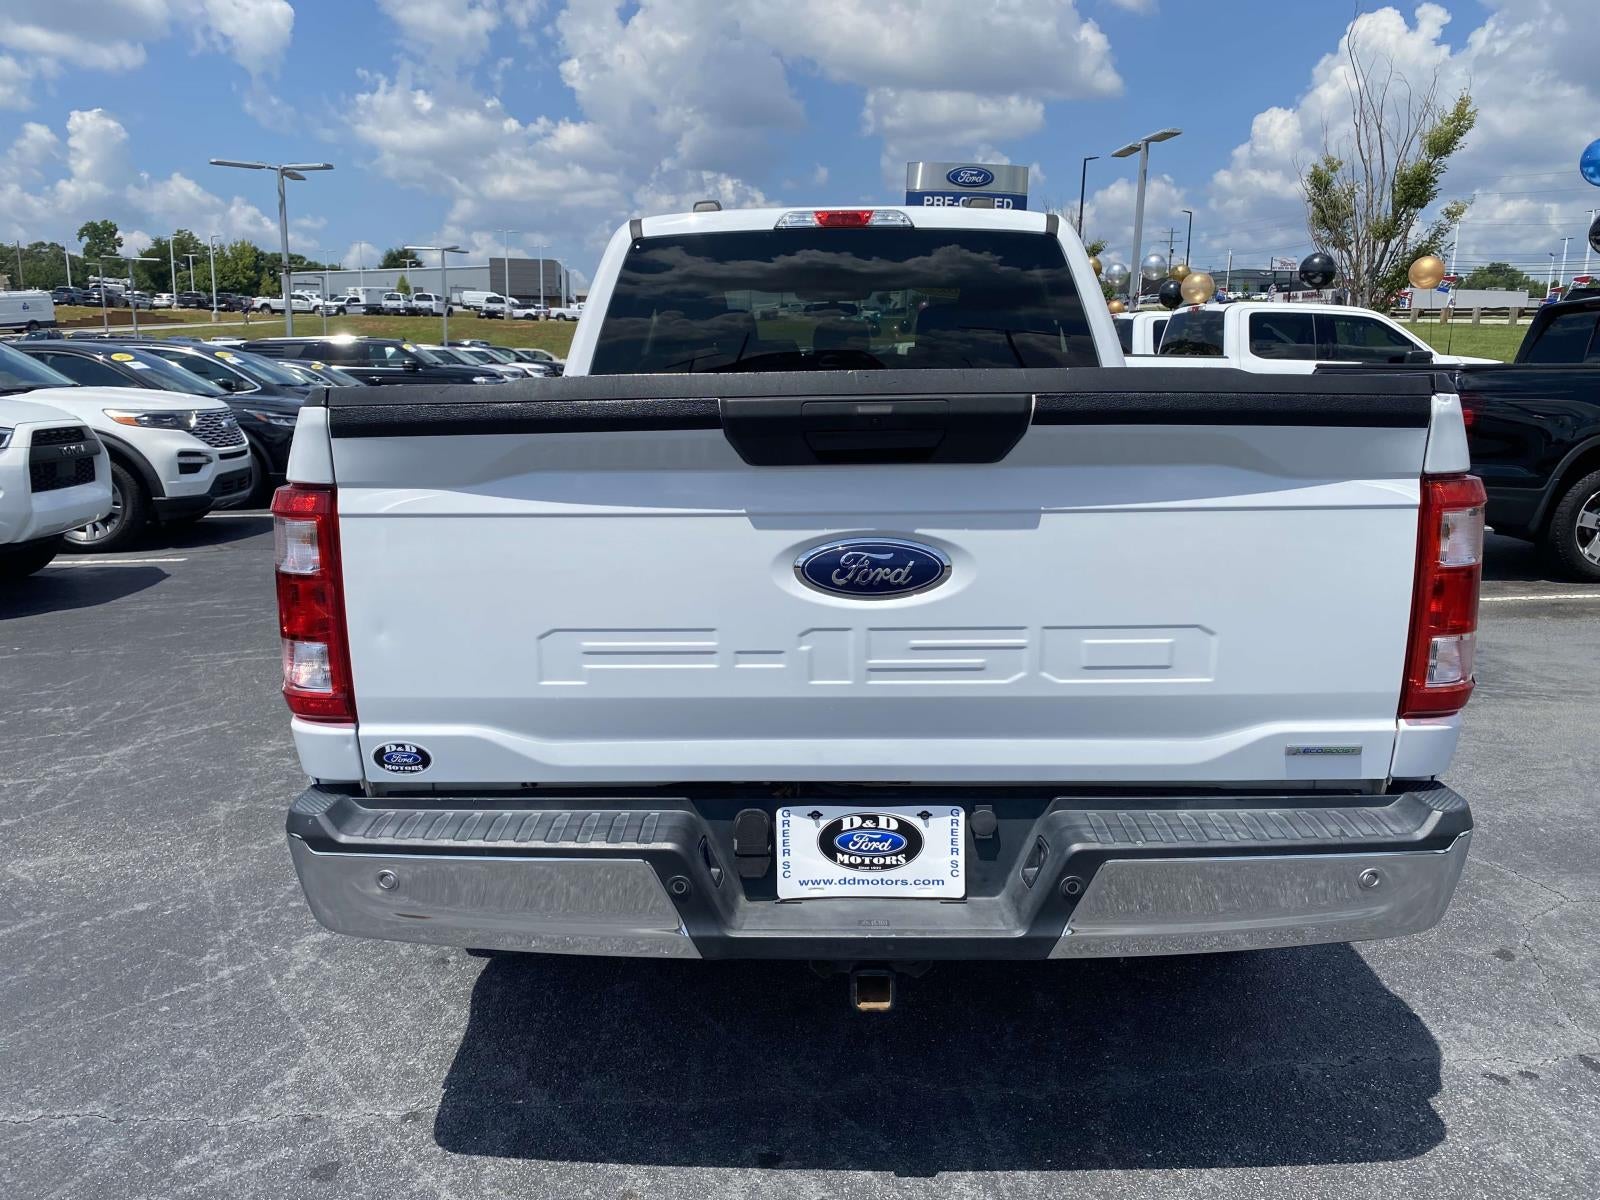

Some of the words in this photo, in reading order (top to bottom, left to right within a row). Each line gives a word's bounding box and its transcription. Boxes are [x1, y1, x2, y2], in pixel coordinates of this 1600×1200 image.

[957, 170, 984, 183] Ford
[924, 196, 1013, 209] PRE-ED
[832, 550, 914, 587] Ford
[536, 624, 1220, 685] F-150
[385, 744, 417, 753] D&D
[391, 754, 414, 763] Ford
[384, 763, 423, 771] MOTORS
[841, 815, 899, 831] D&D
[781, 809, 792, 857] GREER
[950, 808, 960, 856] GREER
[849, 832, 892, 851] Ford
[836, 852, 907, 865] MOTORS
[782, 860, 792, 879] SC
[950, 859, 960, 878] SC
[798, 876, 945, 886] www.ddmotors.com
